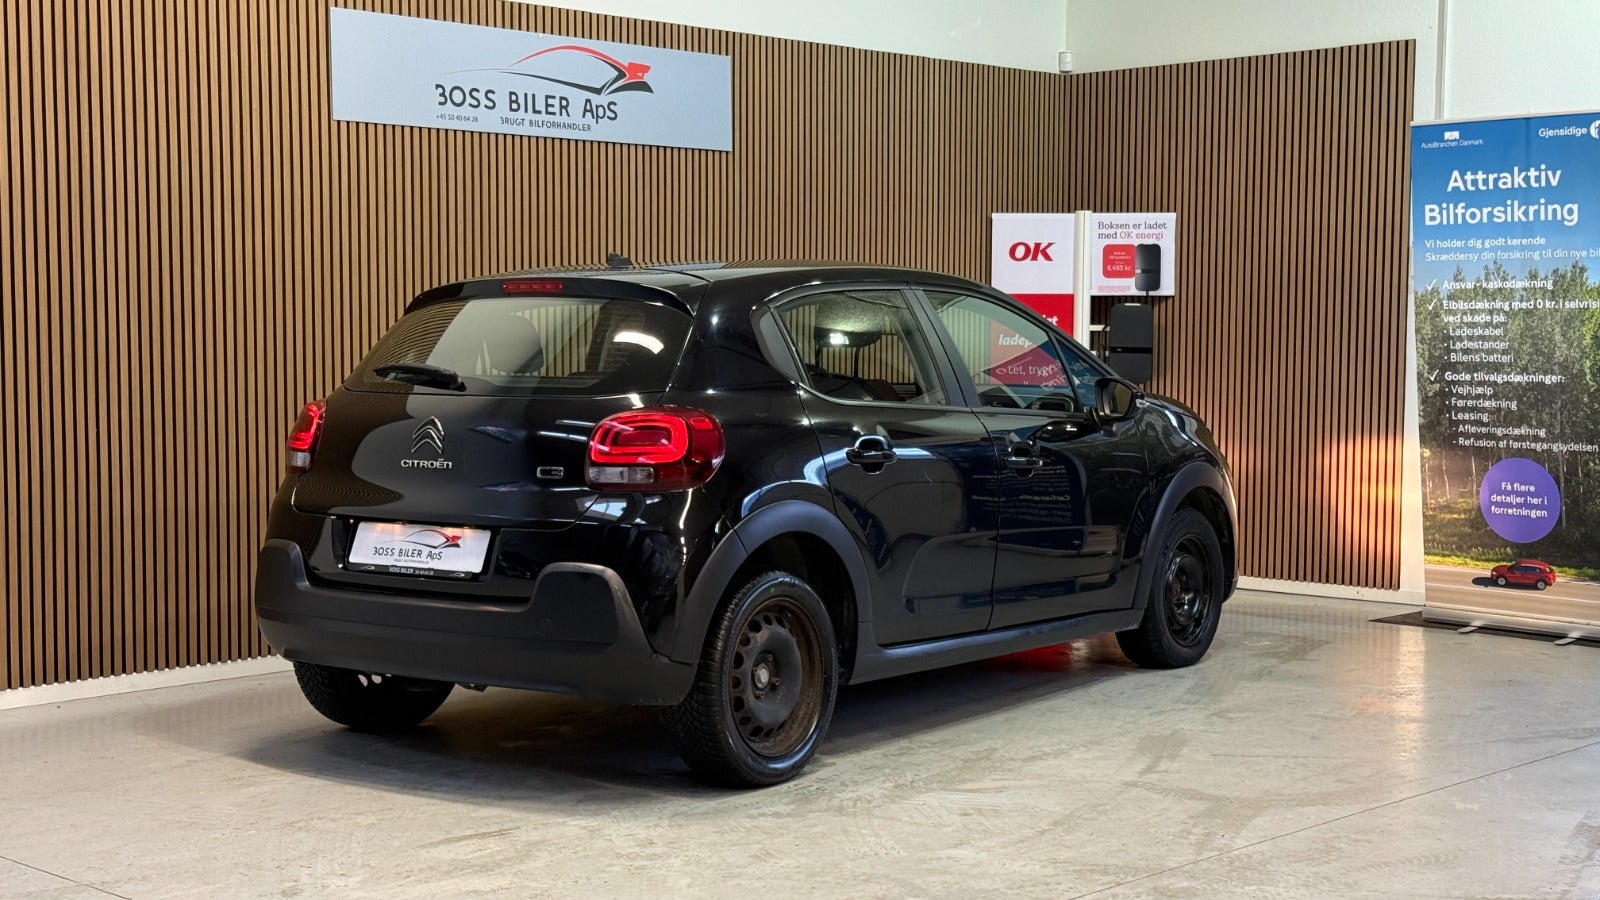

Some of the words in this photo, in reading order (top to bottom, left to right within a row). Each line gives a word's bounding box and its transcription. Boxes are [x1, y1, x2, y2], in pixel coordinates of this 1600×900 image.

[509, 91, 571, 117] BILER
[582, 98, 618, 124] ApS
[529, 120, 592, 132] BILFORHANDLER
[1538, 126, 1587, 139] Gjensidige
[1446, 164, 1561, 192] Attraktiv
[1424, 198, 1578, 226] Bilforsikring
[1098, 221, 1130, 230] Boksen
[1144, 221, 1167, 230] ladet
[1098, 231, 1117, 239] med
[1120, 231, 1134, 239] OK
[1136, 231, 1164, 241] energi
[1425, 240, 1434, 248] Vi
[1436, 239, 1465, 248] holder
[1467, 238, 1482, 249] dig
[1484, 237, 1505, 248] godt
[1507, 236, 1546, 246] kørende
[1008, 241, 1056, 262] OK
[1426, 253, 1477, 262] Skræddersy
[1480, 251, 1494, 260] din
[1497, 250, 1539, 261] forsikring
[1542, 249, 1551, 258] til
[1554, 249, 1568, 258] din
[1570, 250, 1587, 260] nye
[1482, 279, 1553, 290] kaskodækning
[1443, 300, 1509, 311] Elbilsdækning
[1512, 299, 1534, 309] med
[1536, 299, 1543, 308] 0
[1545, 299, 1558, 308] kr.
[1444, 314, 1461, 323] ved
[1463, 314, 1491, 323] skade
[1493, 313, 1507, 325] på:
[1449, 327, 1504, 336] Ladeskabel
[1450, 340, 1509, 349] Ladestander
[1450, 353, 1480, 362] Bilens
[1482, 353, 1514, 362] batteri
[1444, 371, 1472, 381] Gode
[1473, 372, 1565, 384] tilvalgsdækninger:
[1451, 385, 1493, 395] Vejhjælp
[1451, 398, 1518, 410] Førerdækning
[1458, 424, 1546, 438] Afleveringsdækning
[1458, 438, 1496, 447] Refusion
[1498, 438, 1507, 448] af
[1509, 440, 1598, 453] førstegangsydelsen
[1501, 482, 1511, 492] Få
[1513, 483, 1535, 492] flere
[1490, 493, 1526, 506] detaljer
[1528, 495, 1542, 504] her
[1490, 506, 1547, 518] forretningen
[398, 548, 422, 559] BILER
[426, 549, 443, 561] ApS
